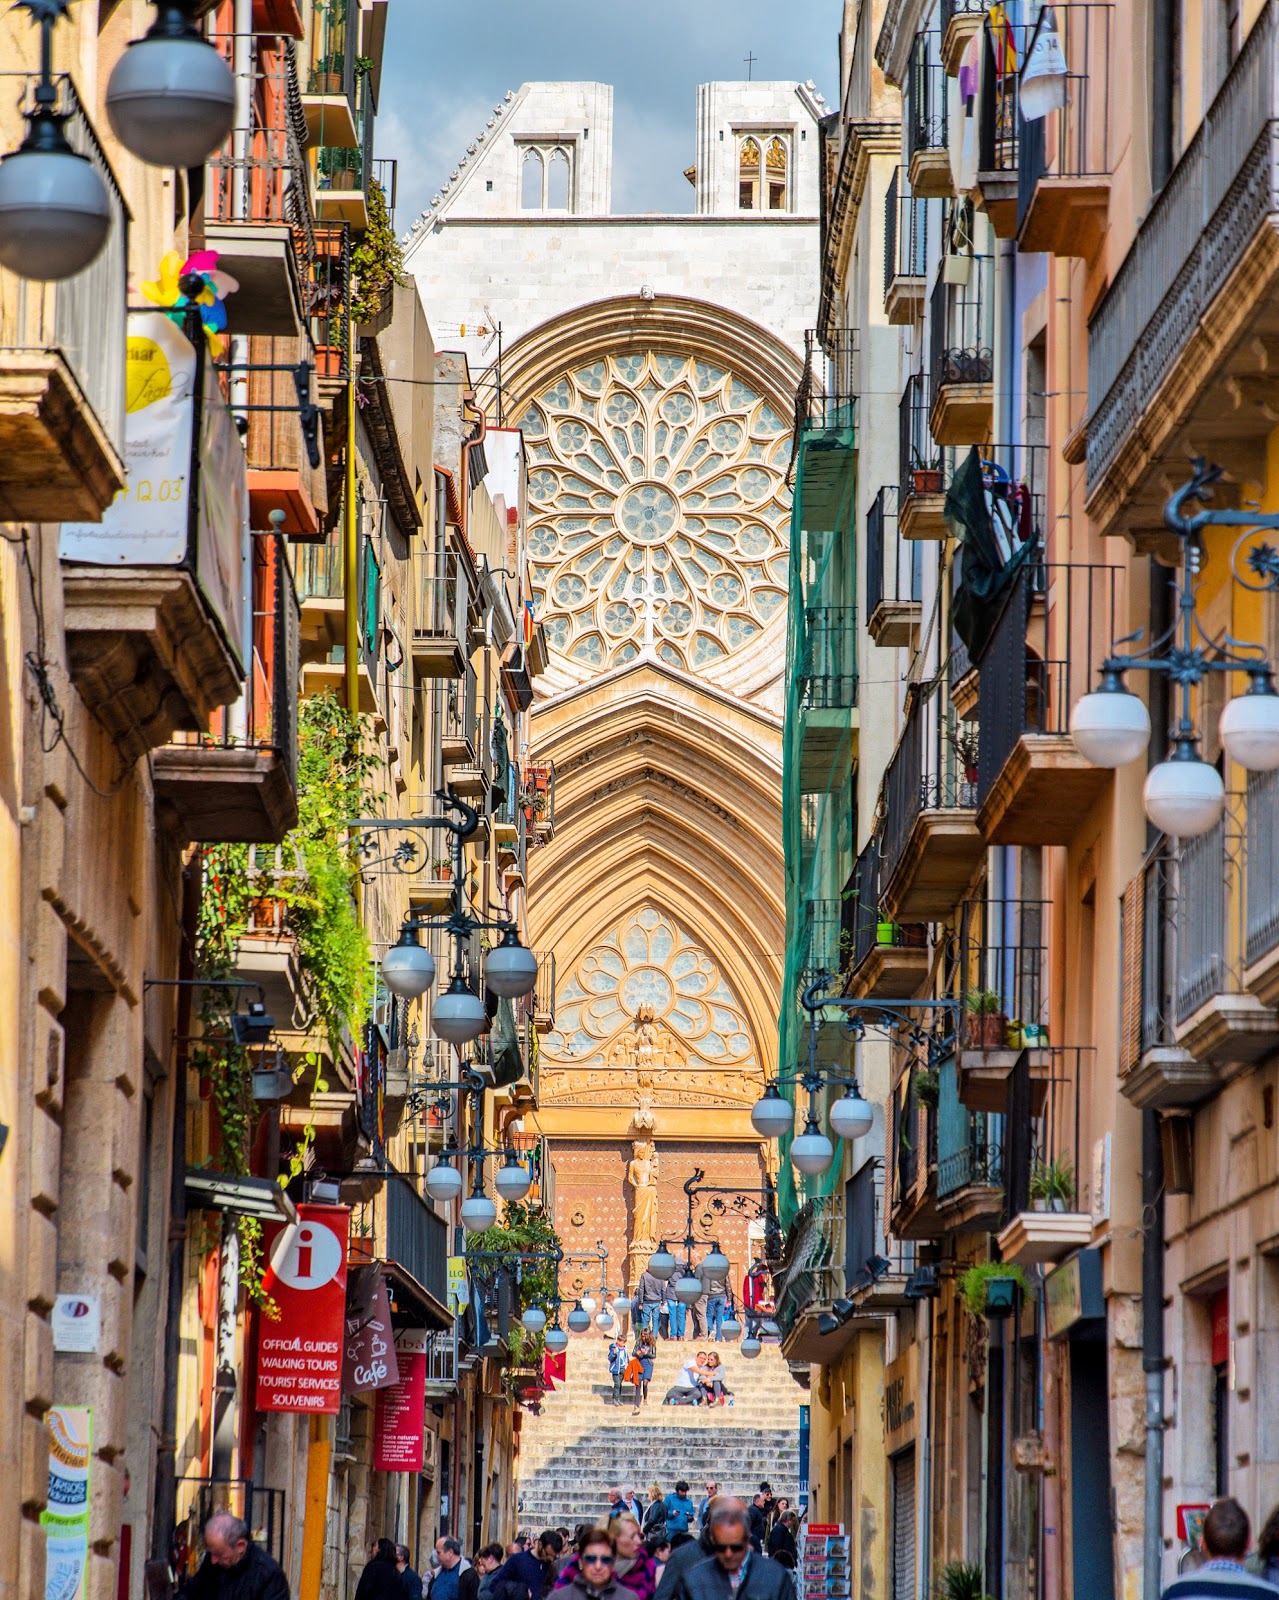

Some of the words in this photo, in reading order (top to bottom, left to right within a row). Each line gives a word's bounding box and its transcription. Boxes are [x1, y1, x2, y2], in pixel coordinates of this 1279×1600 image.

[263, 1338, 302, 1351] OFFICIAL
[304, 1341, 338, 1353] GUIDES
[262, 1357, 305, 1370] WALKING
[306, 1359, 338, 1371] TOURS
[354, 1359, 387, 1387] Café
[258, 1375, 297, 1388] TOURIST
[298, 1377, 340, 1390] SERVICES
[272, 1393, 325, 1407] SOUVENIRS
